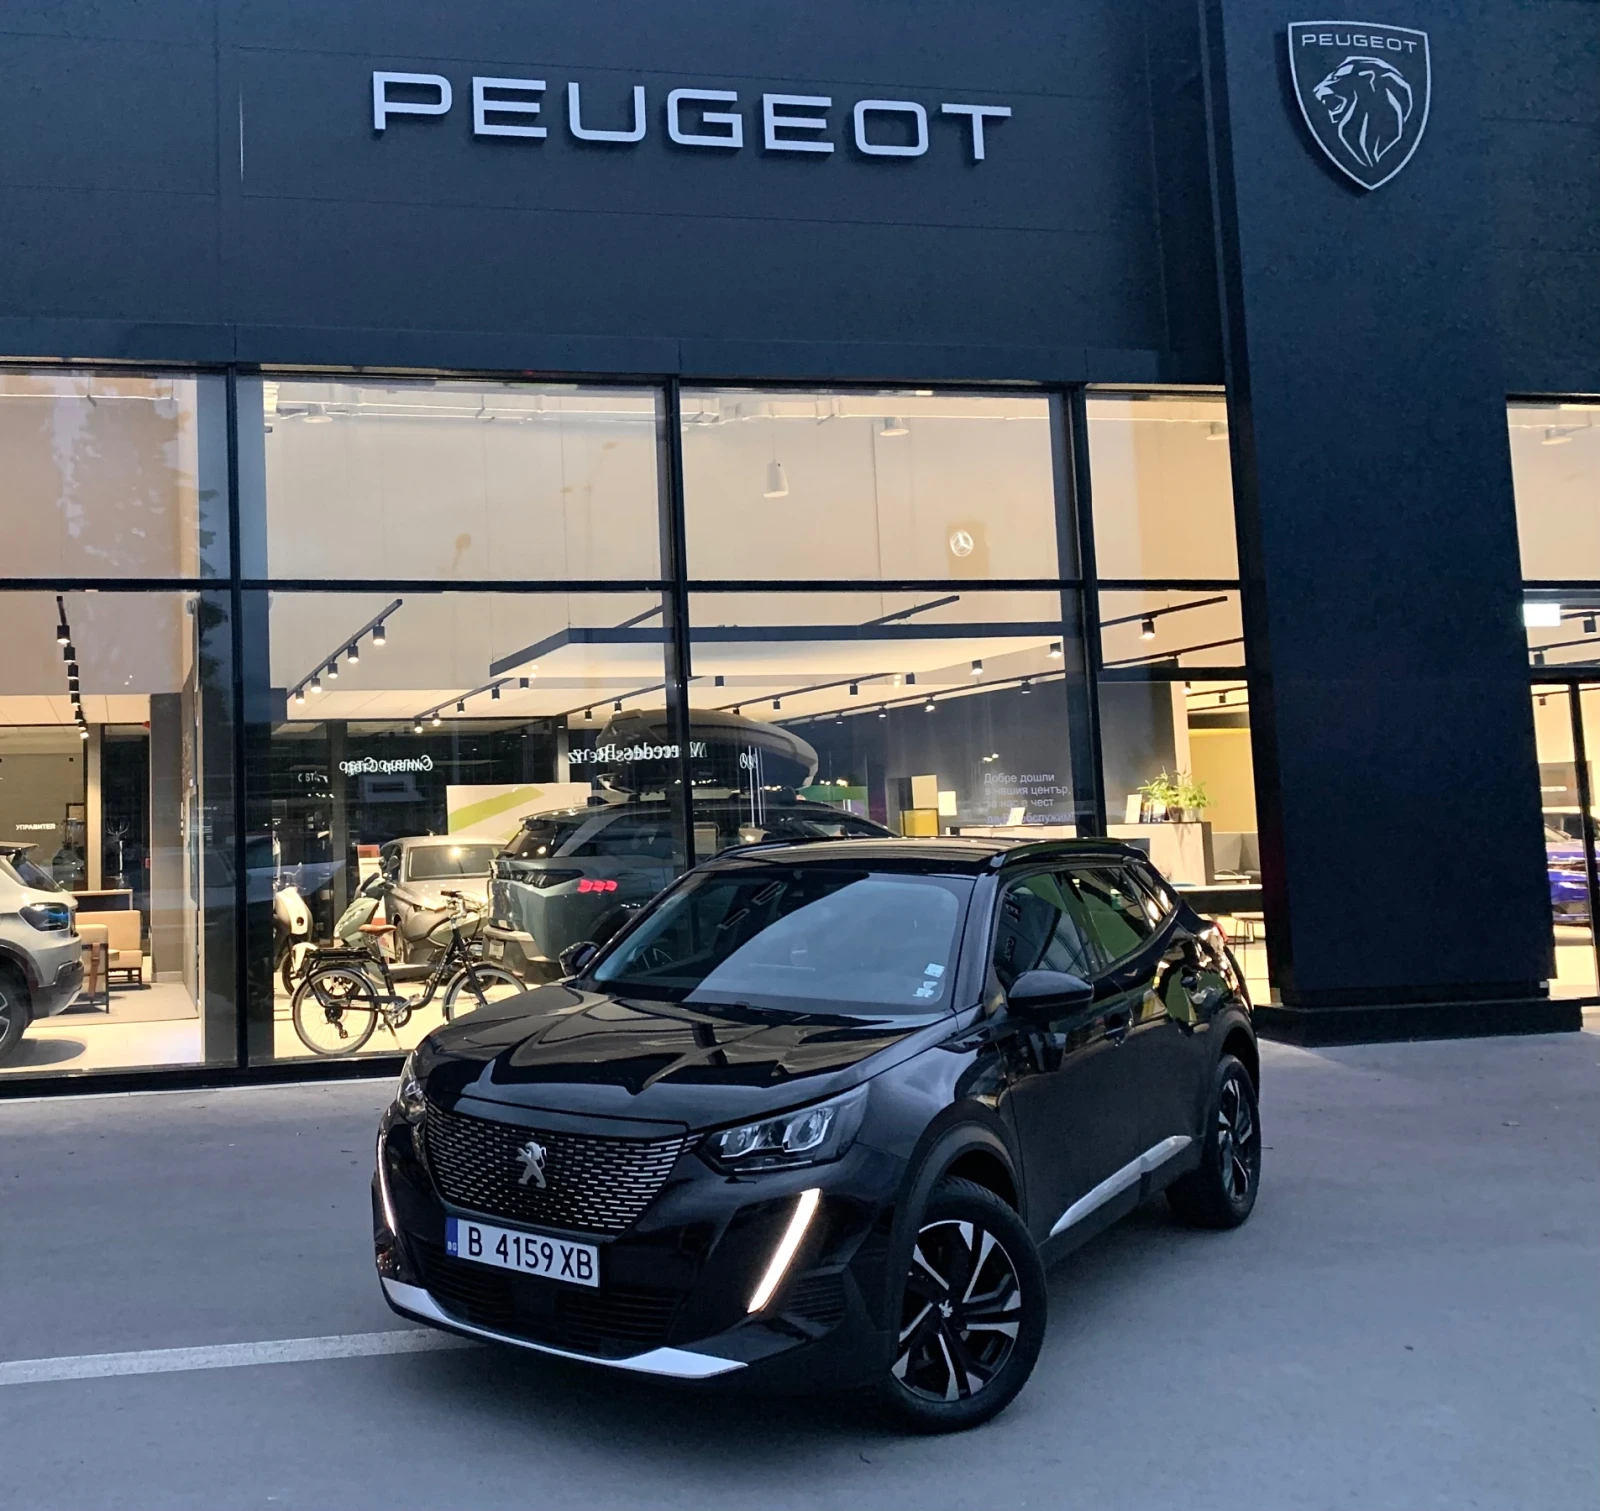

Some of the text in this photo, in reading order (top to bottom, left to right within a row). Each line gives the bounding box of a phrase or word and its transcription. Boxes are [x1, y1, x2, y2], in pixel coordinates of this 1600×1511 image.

[1302, 33, 1417, 53] PEUGEOT
[372, 71, 1012, 160] PEUGEOT
[984, 773, 1055, 785] Добре дошли
[1000, 799, 1018, 808] нас
[1021, 799, 1028, 808] е
[1030, 798, 1054, 808] чест
[468, 1226, 483, 1257] B
[495, 1233, 553, 1272] 4159
[560, 1245, 593, 1280] XB
